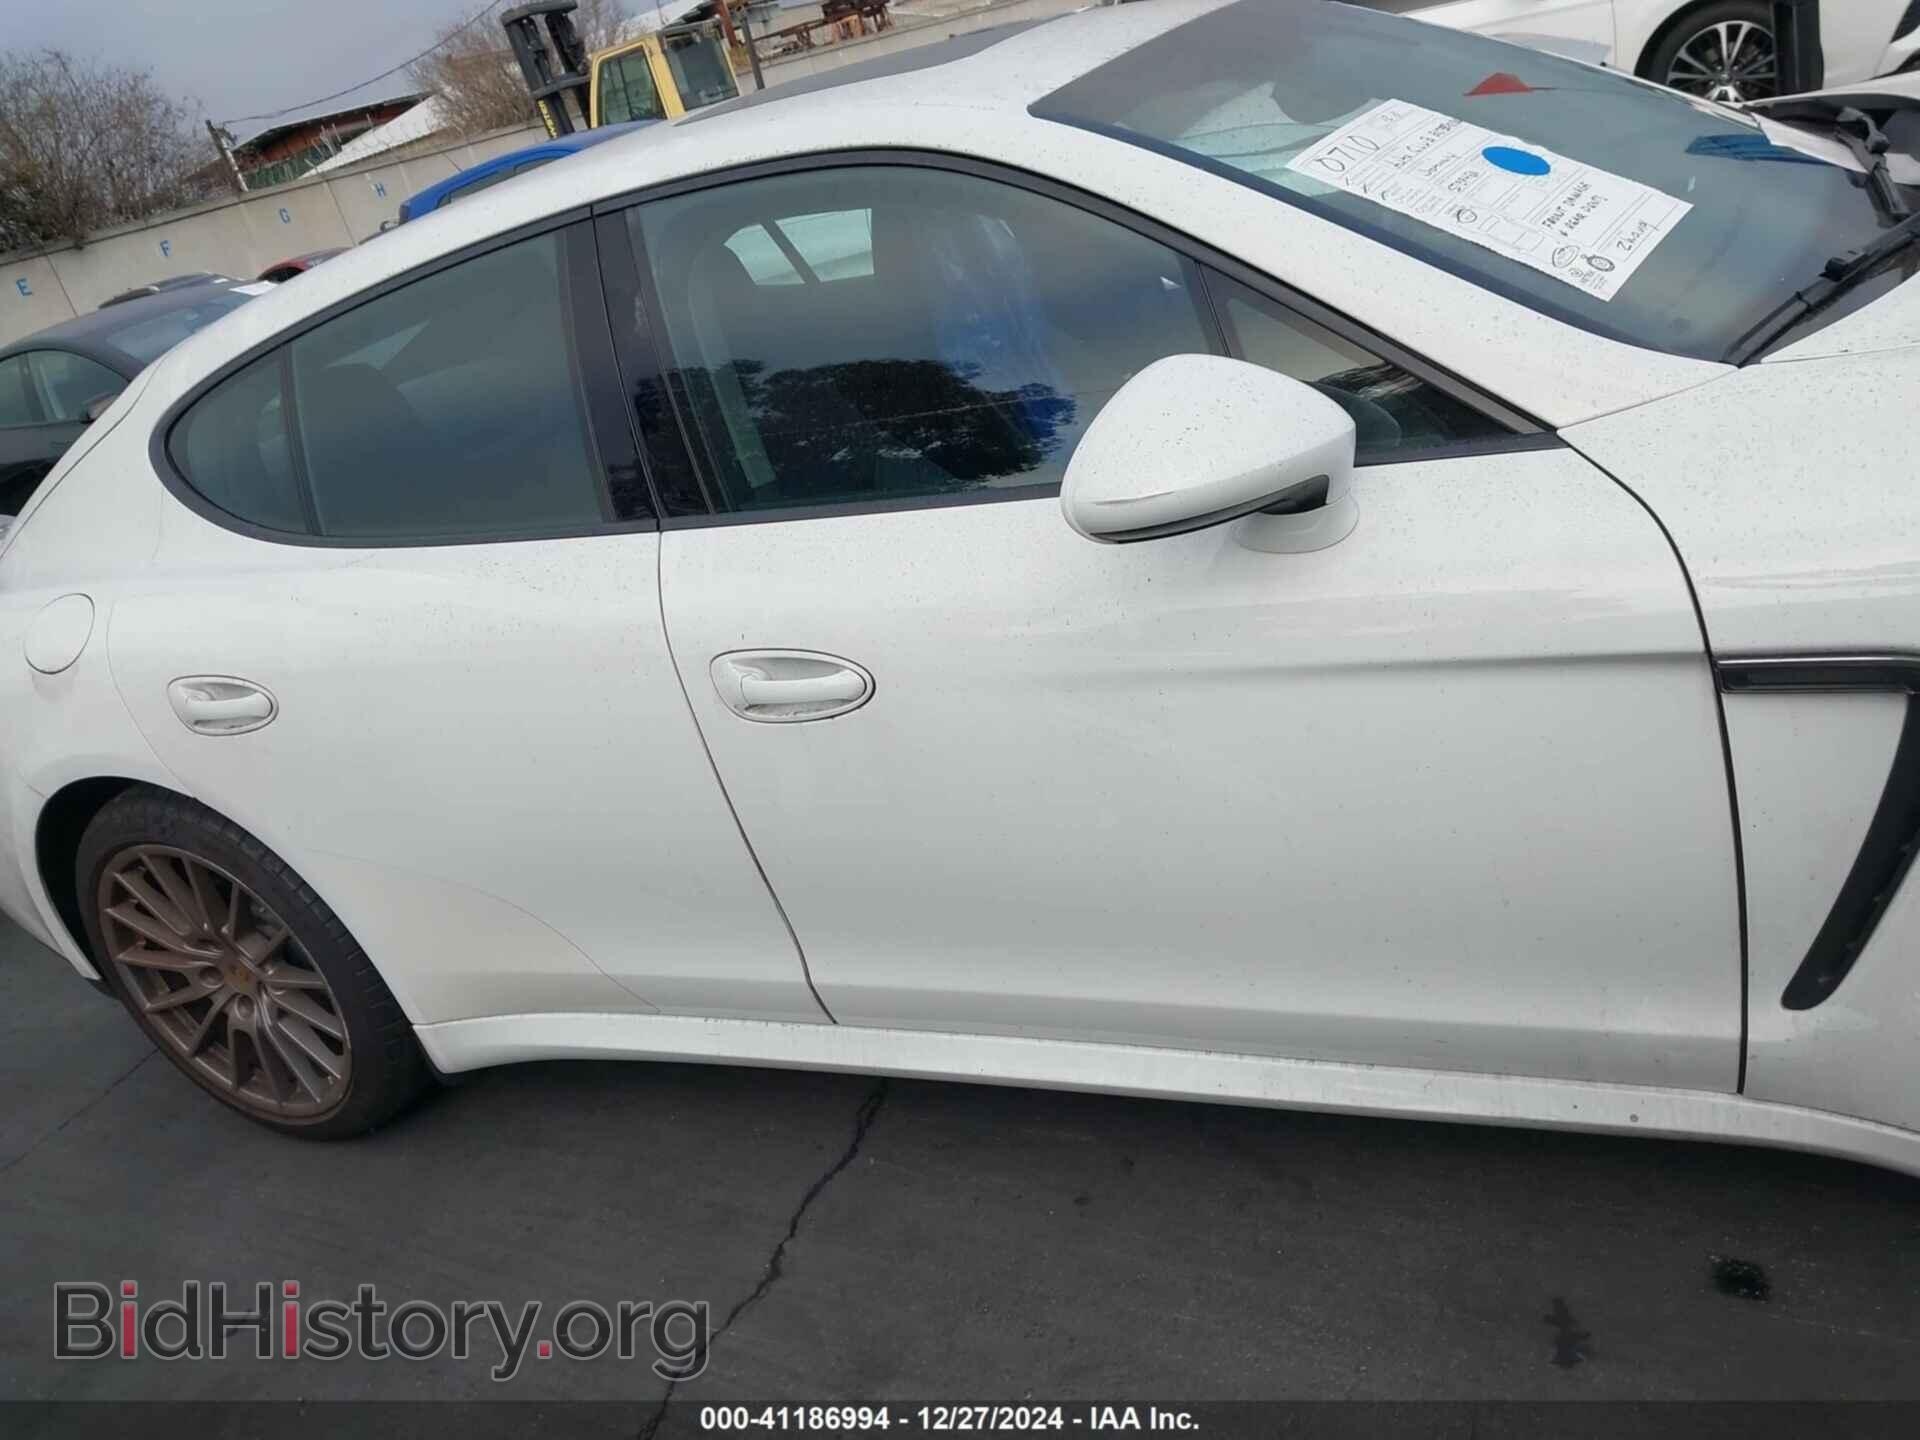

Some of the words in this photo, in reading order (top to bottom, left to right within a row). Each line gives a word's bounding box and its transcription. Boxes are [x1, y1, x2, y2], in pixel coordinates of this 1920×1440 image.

[1312, 135, 1380, 173] 0710
[374, 183, 385, 198] H
[279, 207, 291, 224] G
[160, 240, 170, 257] F
[15, 278, 33, 296] E
